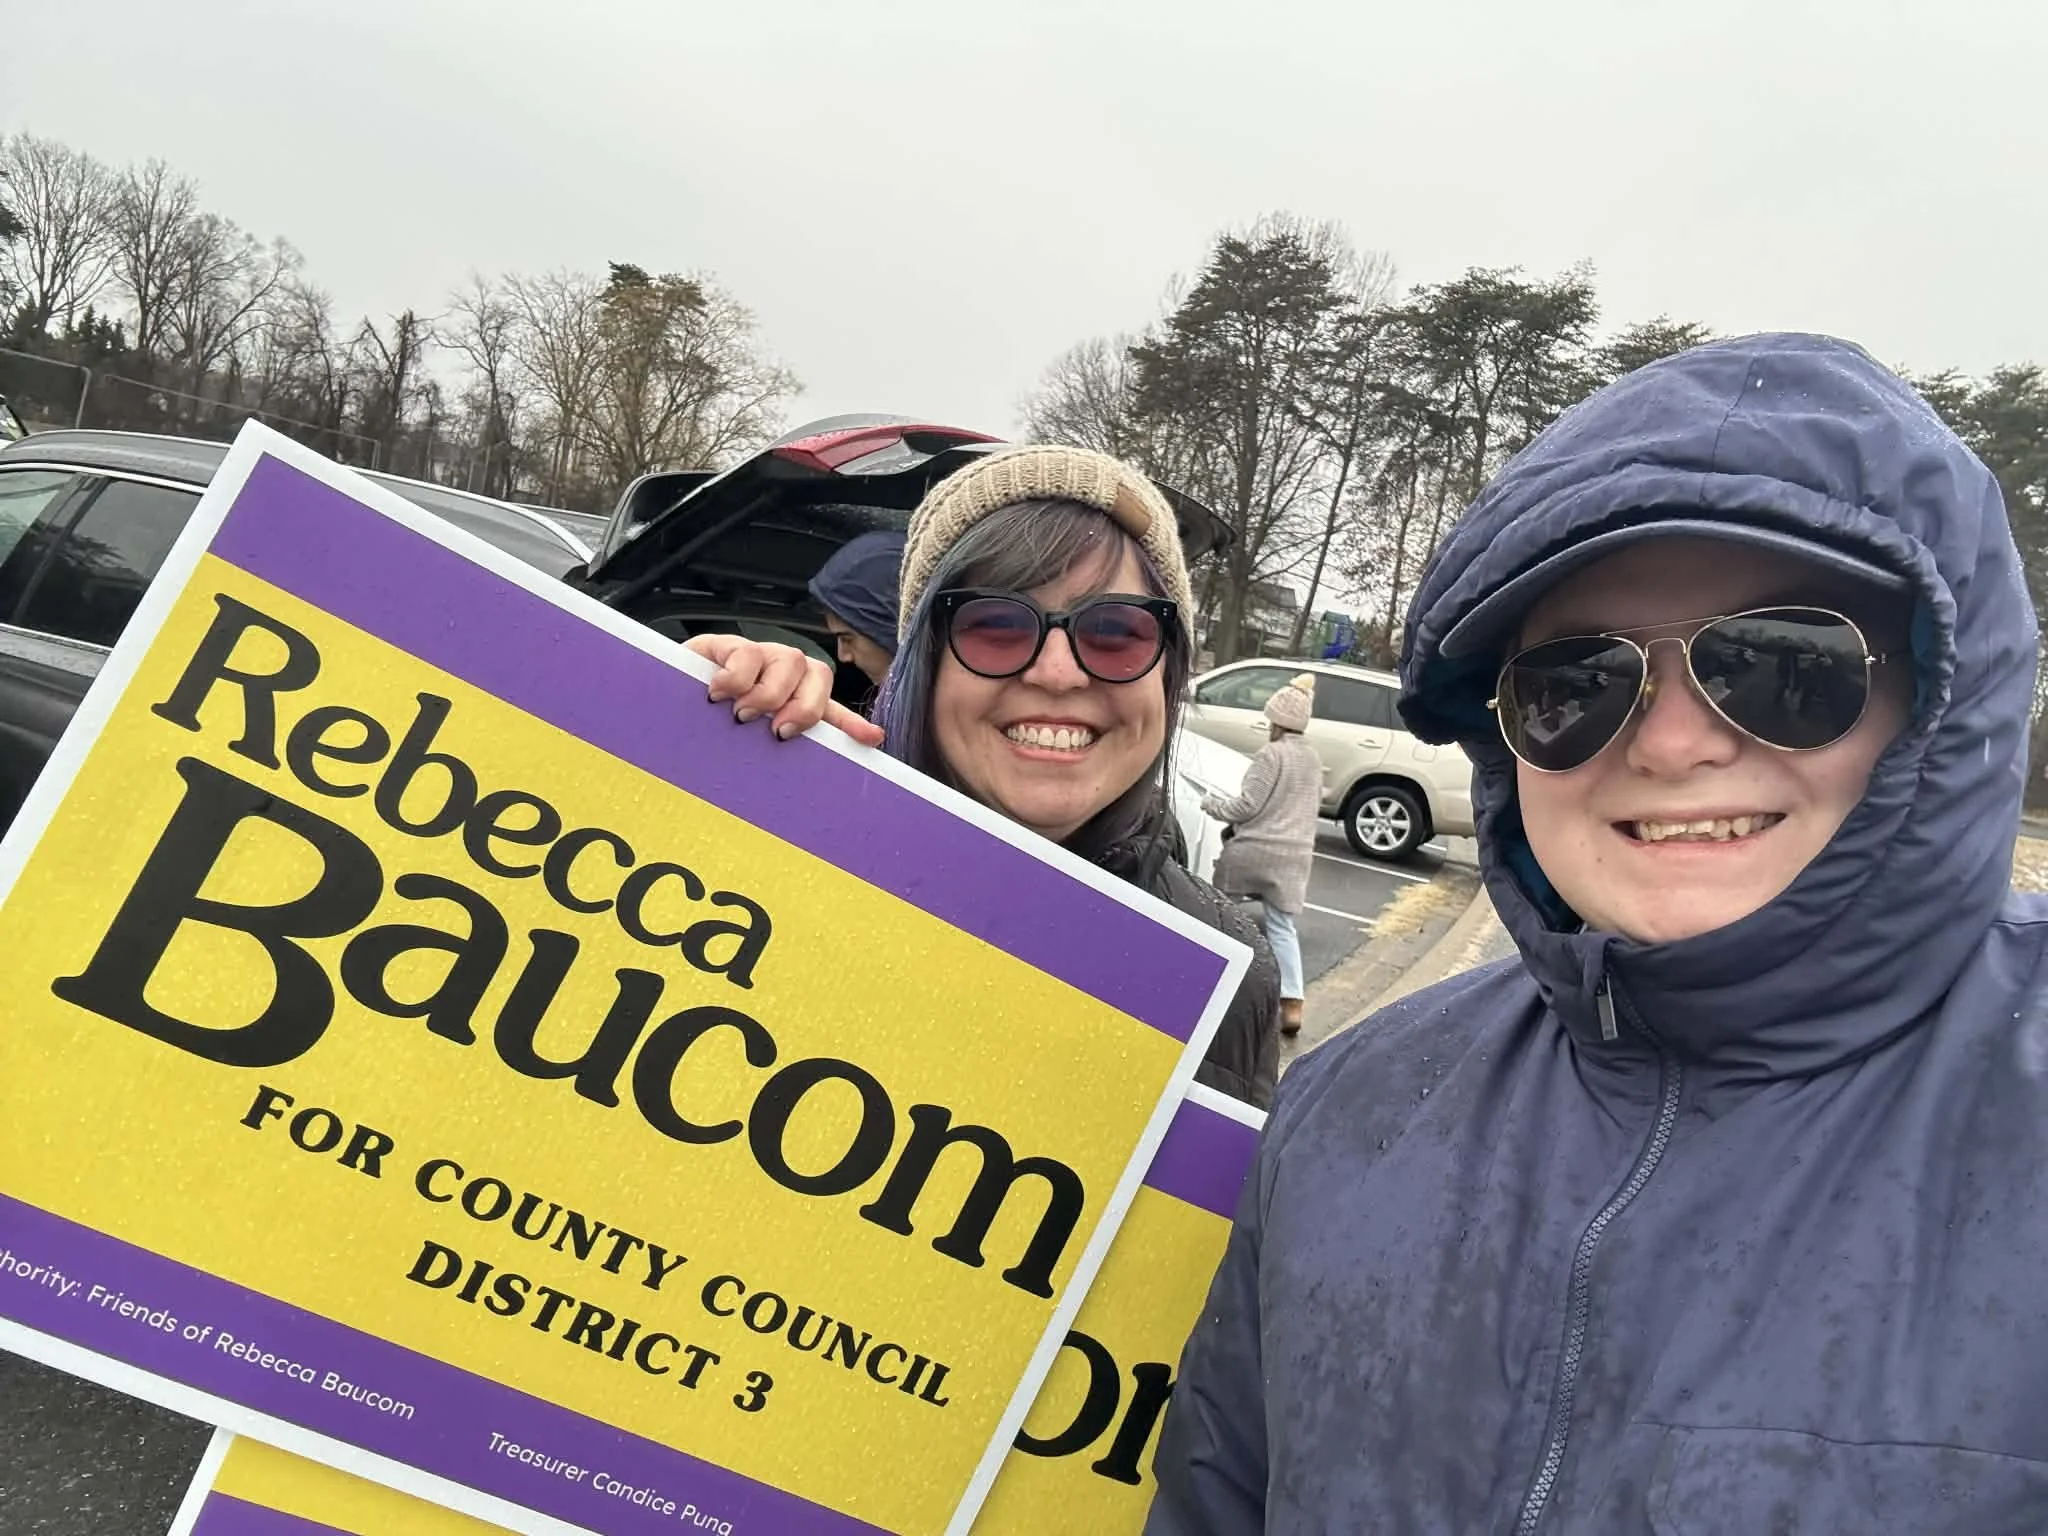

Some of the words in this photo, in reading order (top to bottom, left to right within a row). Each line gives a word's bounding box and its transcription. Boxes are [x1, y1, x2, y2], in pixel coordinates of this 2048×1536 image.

[152, 593, 772, 990] Rebecca
[51, 757, 1085, 1300] Baucom
[0, 1249, 82, 1297] hority:
[86, 1284, 178, 1333] Friends
[182, 1324, 214, 1344] of
[213, 1331, 317, 1384] Rebecca
[320, 1371, 415, 1421] Baucom
[488, 1431, 590, 1483] Treasurer
[592, 1472, 676, 1515] Candice
[240, 1084, 394, 1179] FOR
[416, 1159, 688, 1291] COUNTY
[701, 1275, 951, 1408] COUNCIL
[406, 1240, 721, 1390] DISTRICT
[733, 1371, 774, 1413] 3
